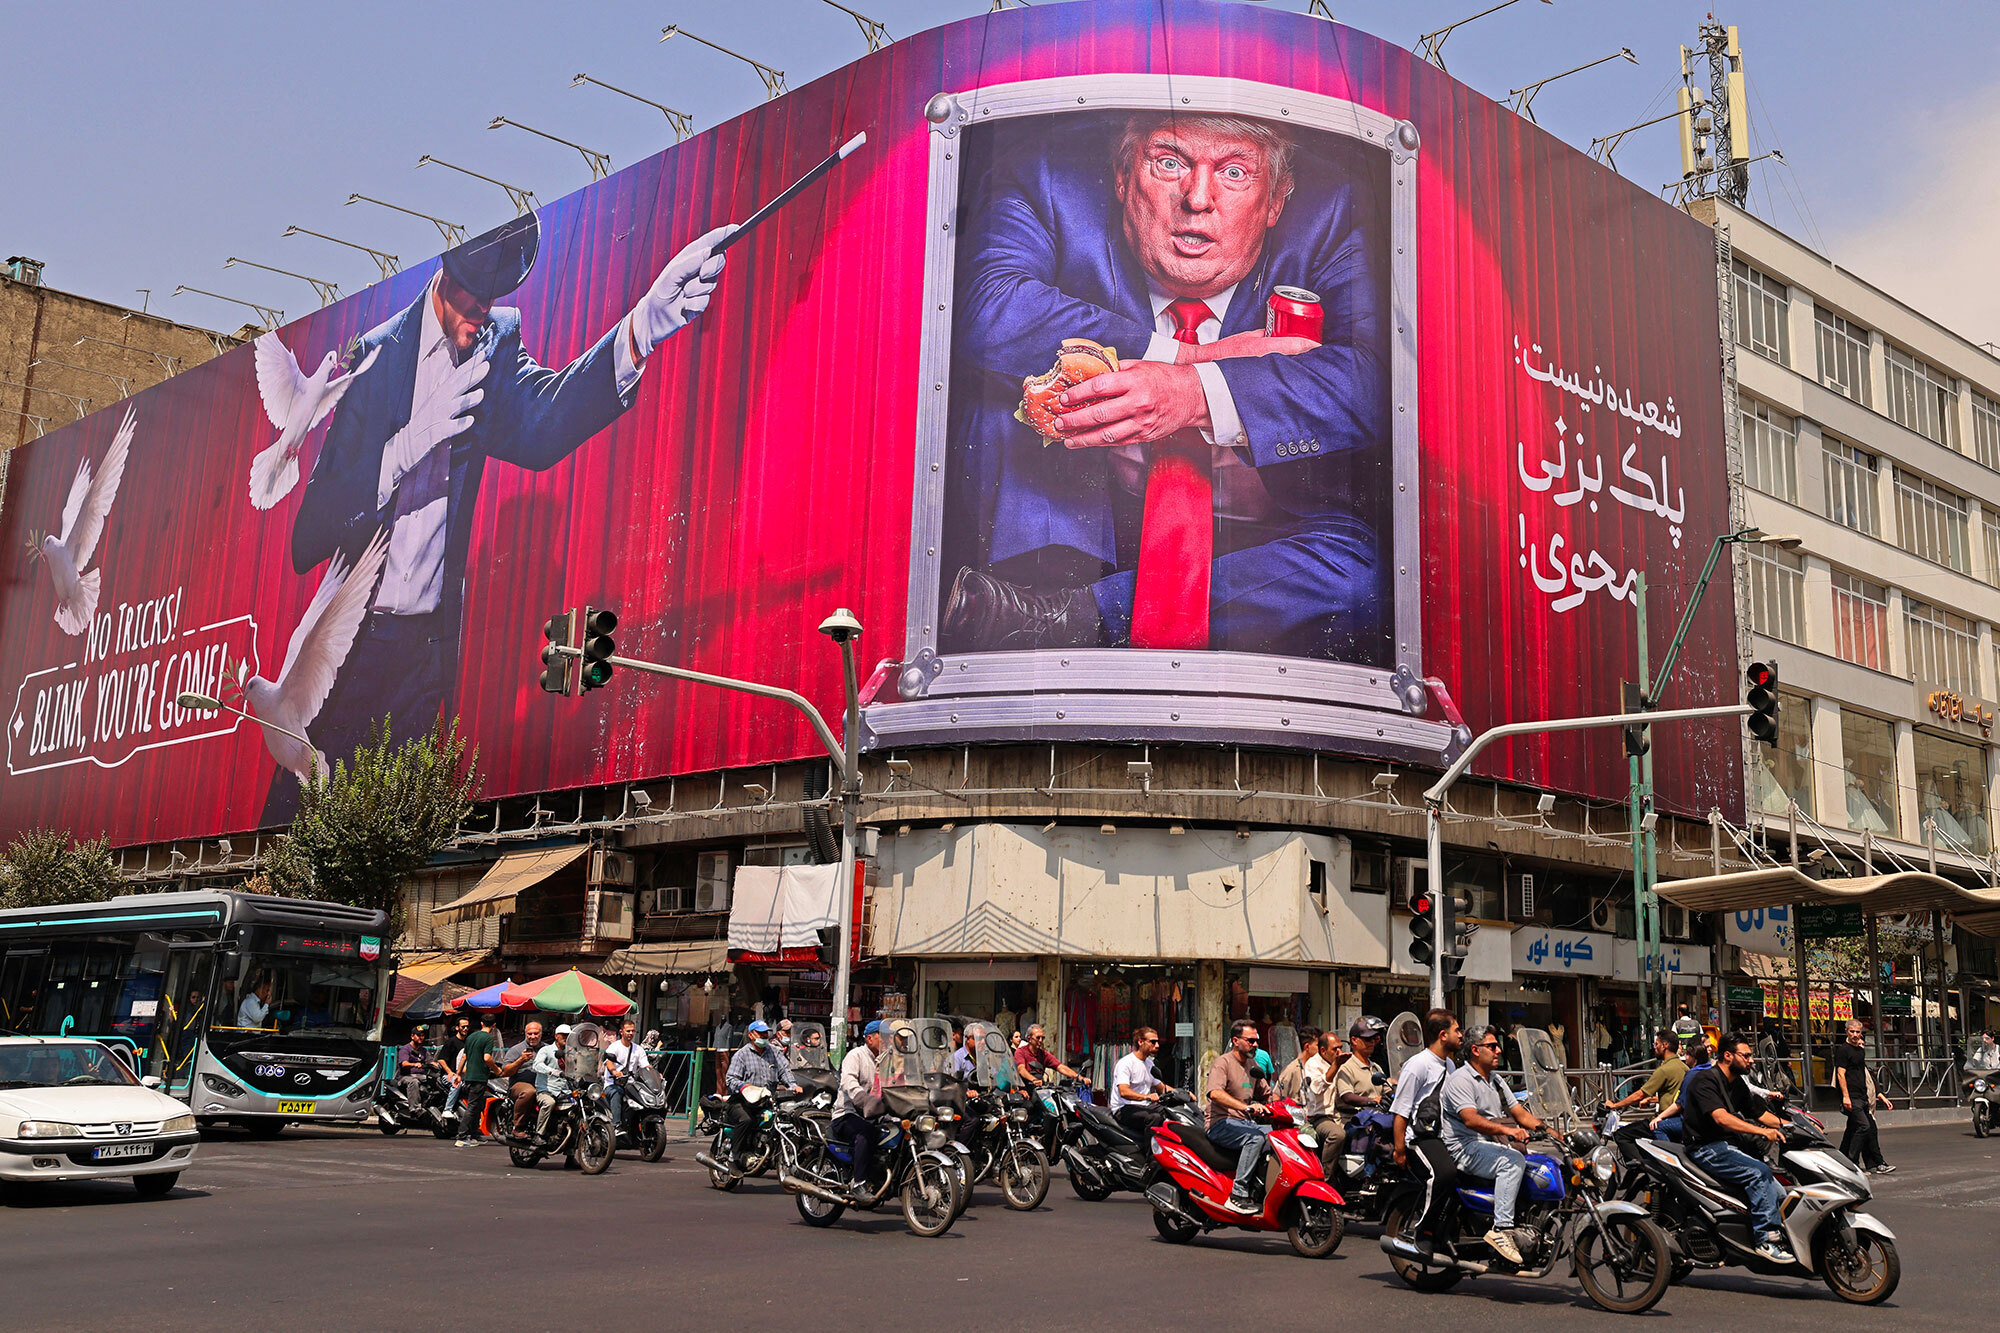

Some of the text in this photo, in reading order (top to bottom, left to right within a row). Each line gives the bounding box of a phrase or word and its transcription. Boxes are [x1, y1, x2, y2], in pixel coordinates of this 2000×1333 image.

[1606, 384, 1682, 439] شعبده
[1517, 416, 1685, 549] پلک بزنی
[83, 586, 182, 666] NO TRICKS!
[29, 642, 227, 756] BLINK, YOU'RE GONE!
[1527, 933, 1593, 967] کوه نور
